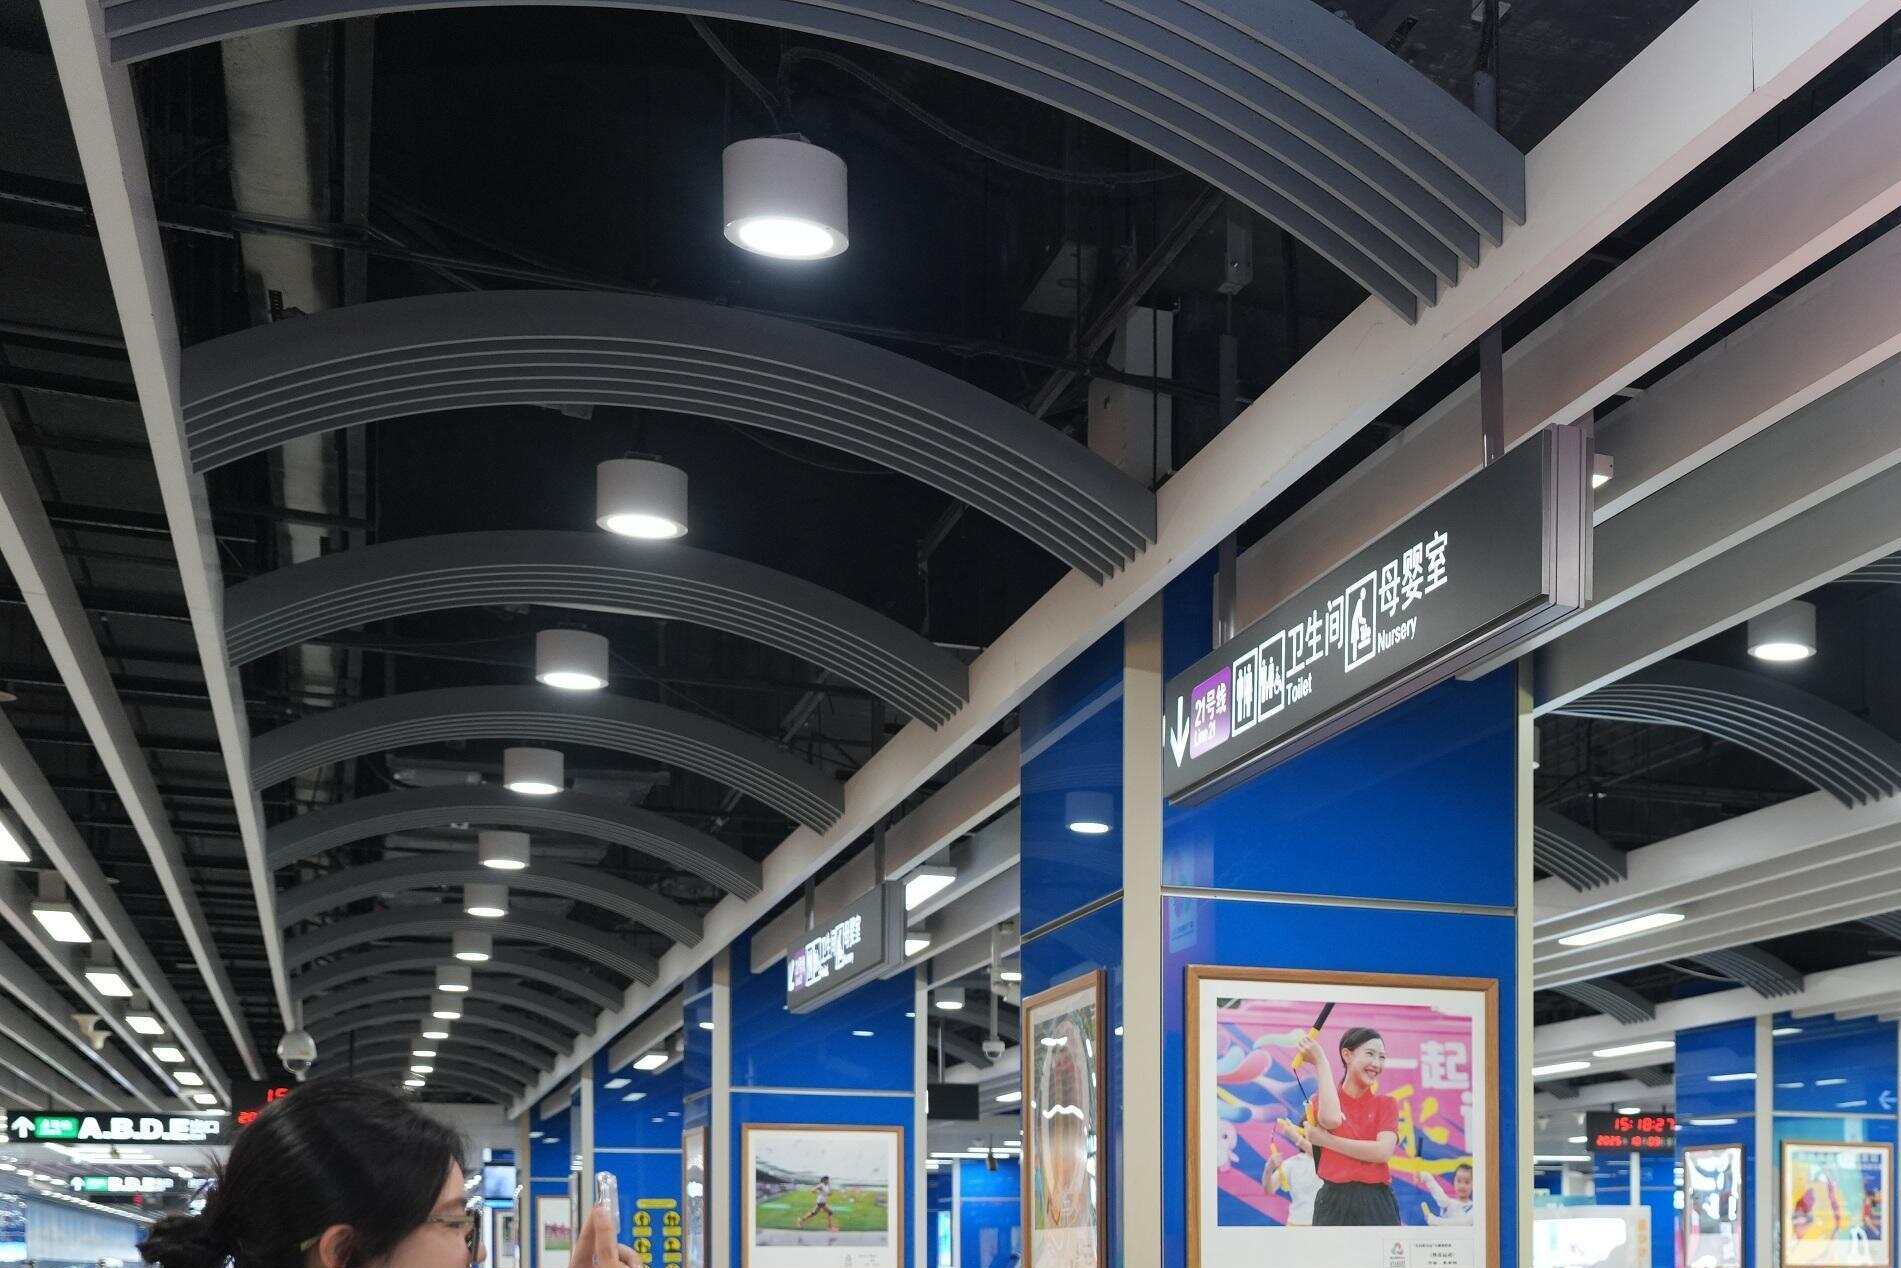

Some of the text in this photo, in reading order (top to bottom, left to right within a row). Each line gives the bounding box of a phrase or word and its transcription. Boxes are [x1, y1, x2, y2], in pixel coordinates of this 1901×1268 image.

[1378, 530, 1448, 619] 母婴室
[1286, 595, 1344, 677] 卫生间
[1377, 616, 1418, 656] Nursery
[1194, 682, 1227, 728] 21号线
[1286, 672, 1313, 706] Toilet
